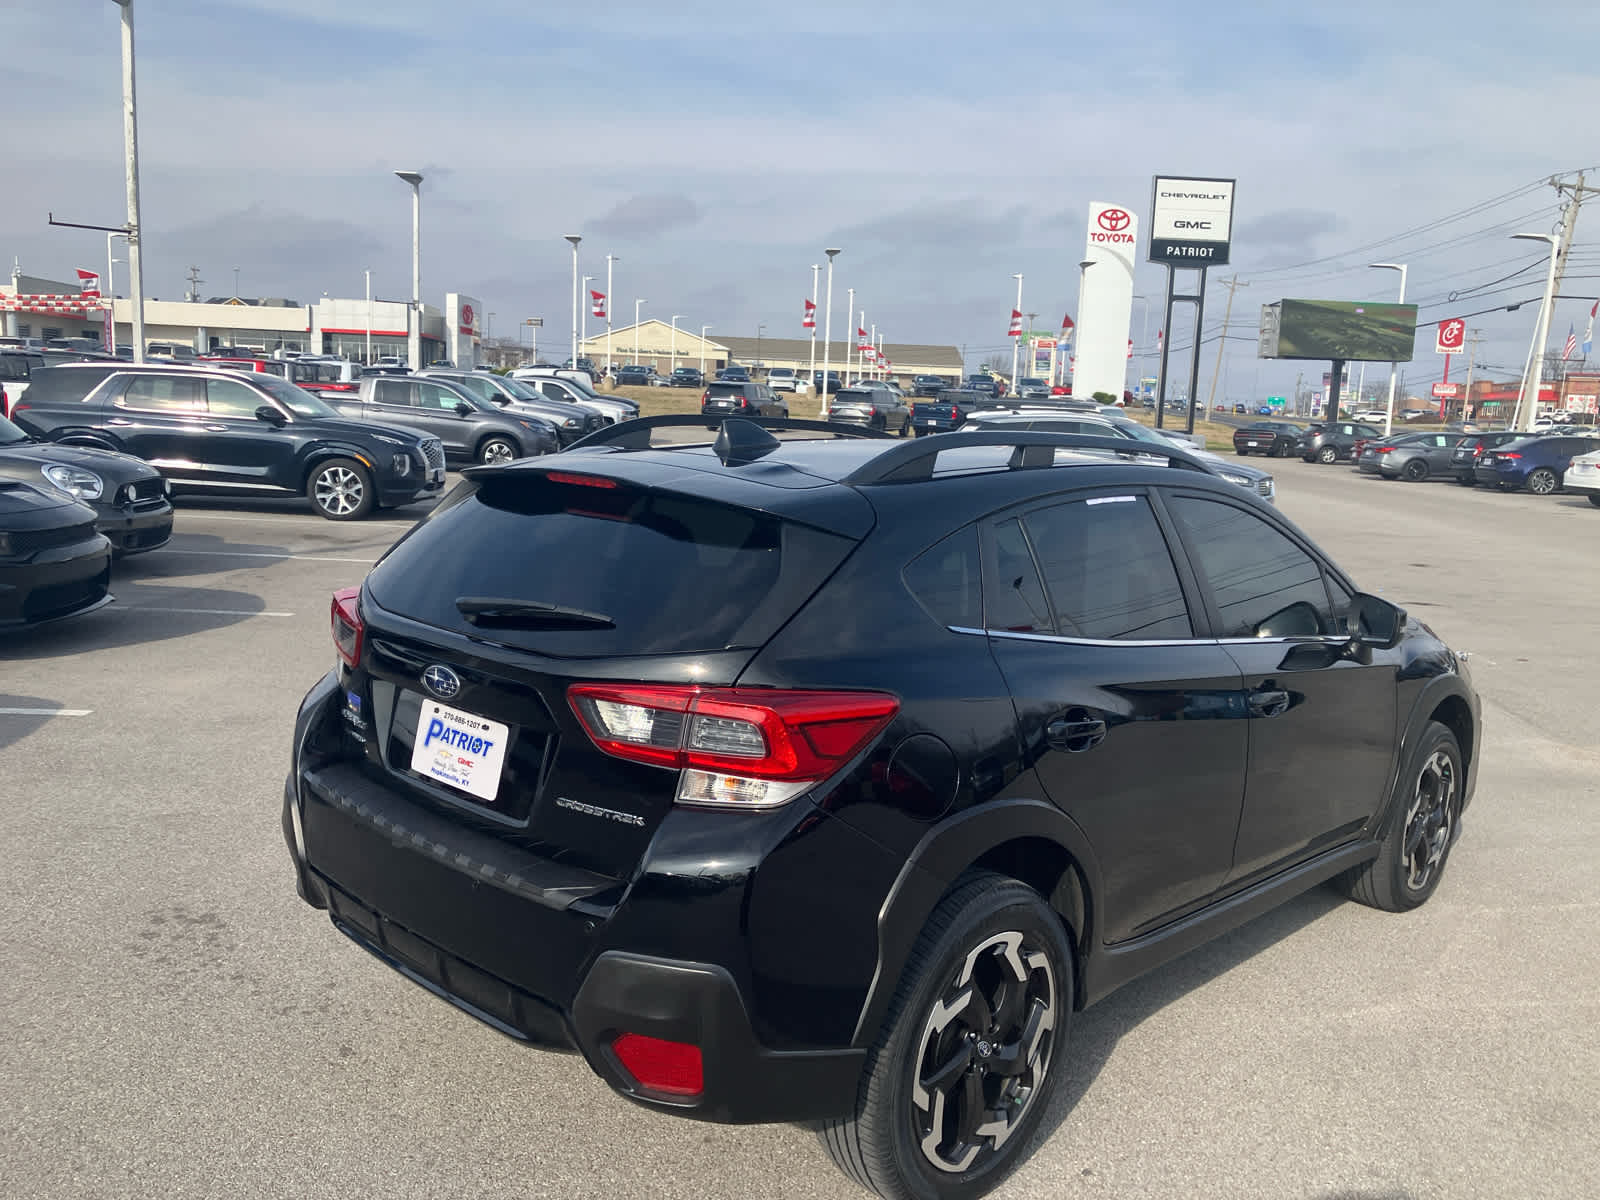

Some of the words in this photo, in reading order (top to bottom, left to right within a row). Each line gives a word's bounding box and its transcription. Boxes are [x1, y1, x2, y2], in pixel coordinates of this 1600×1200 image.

[1161, 192, 1227, 200] CHEVROLET
[1174, 220, 1212, 229] GMC
[1090, 233, 1135, 243] TOYOTA
[1166, 246, 1214, 257] PATRIOT
[424, 717, 494, 757] PATRIOT
[457, 757, 475, 768] GMC
[555, 797, 645, 826] CROSSTREK
